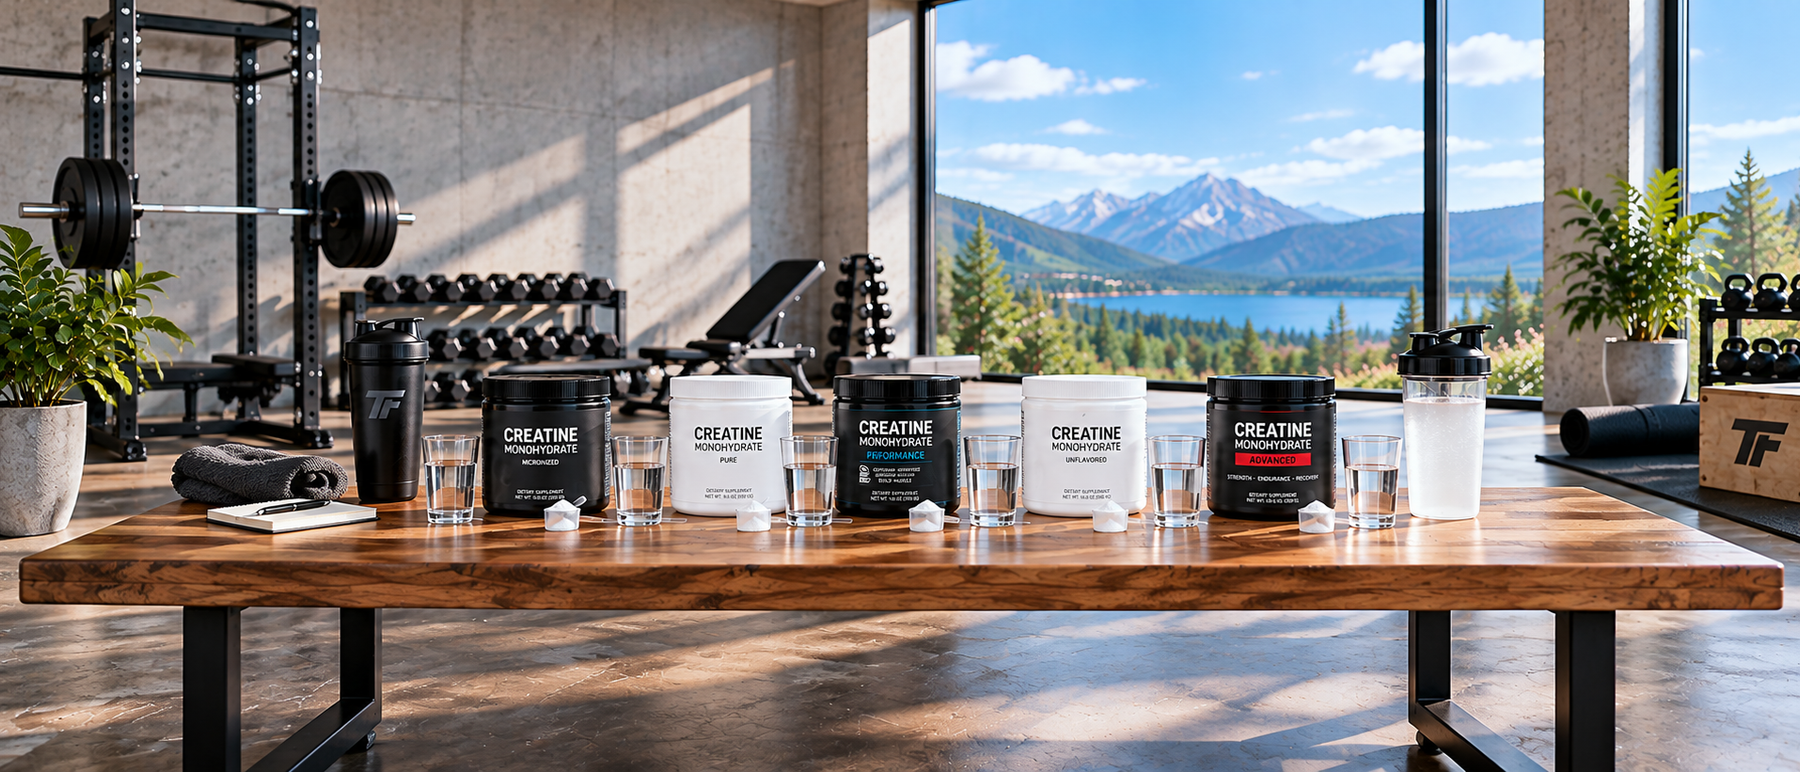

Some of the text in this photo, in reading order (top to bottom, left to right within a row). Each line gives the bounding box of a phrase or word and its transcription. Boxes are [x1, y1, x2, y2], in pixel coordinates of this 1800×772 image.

[366, 390, 406, 419] TF
[694, 426, 763, 440] CREATINE
[859, 420, 933, 435] CREATINE
[1051, 426, 1121, 440] CREATINE
[1235, 422, 1312, 438] CREATINE
[504, 427, 578, 443] CREATINE
[859, 437, 933, 447] MONOHYDRATE
[504, 444, 578, 455] MONOHYDRATE
[694, 442, 763, 452] MONOHYDRATE
[1051, 442, 1121, 452] MONOHYDRATE
[1235, 439, 1312, 450] MONOHYDRATE
[1731, 418, 1789, 468] TF
[1249, 456, 1296, 464] ADVANCED
